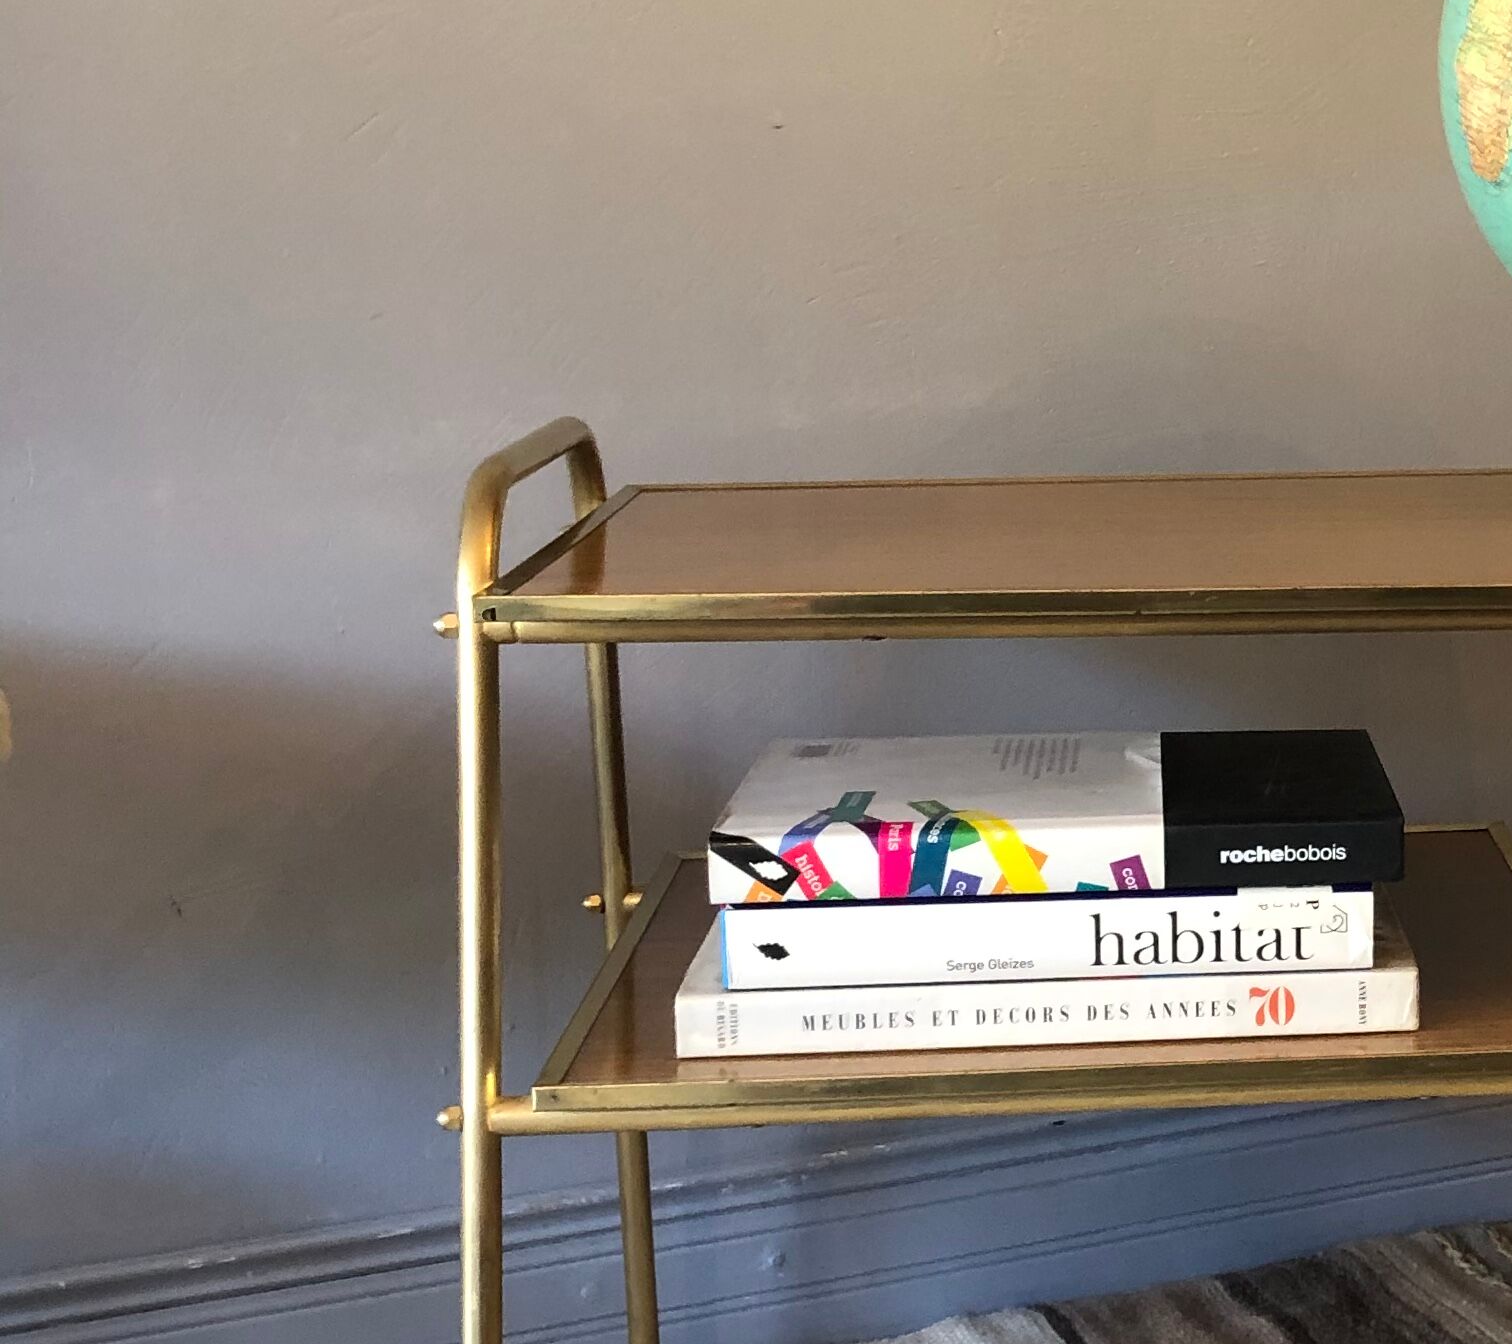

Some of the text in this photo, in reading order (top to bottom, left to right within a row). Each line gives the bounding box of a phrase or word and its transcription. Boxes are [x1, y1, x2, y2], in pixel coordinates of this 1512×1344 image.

[1219, 843, 1347, 864] rochebobois
[1089, 910, 1315, 967] habitat
[946, 958, 1034, 973] Serge Gleizes
[802, 986, 1295, 1032] MEUBLES ET DECORS DES ANNEES 70
